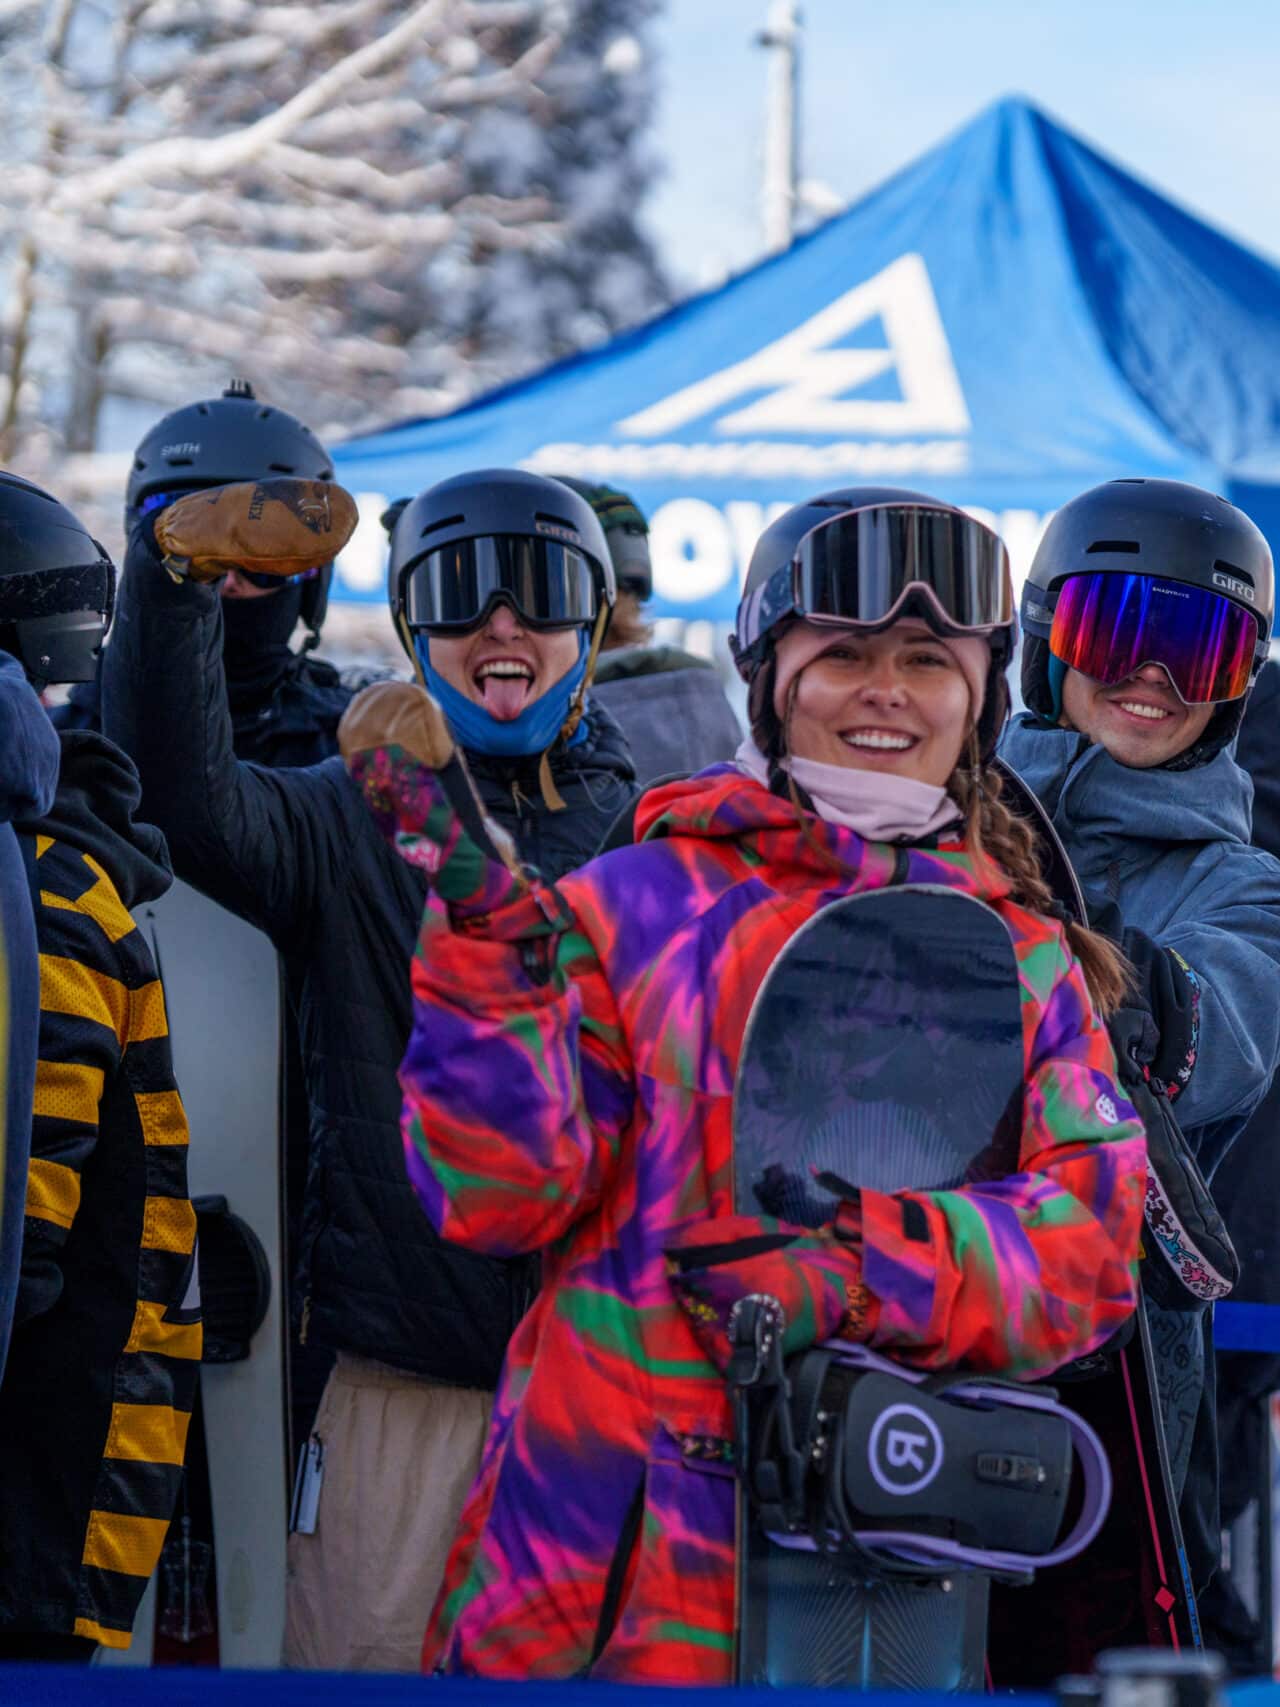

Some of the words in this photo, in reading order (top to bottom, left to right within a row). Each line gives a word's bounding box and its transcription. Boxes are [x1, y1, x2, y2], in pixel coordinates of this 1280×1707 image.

[160, 443, 201, 456] SMITH
[536, 521, 581, 543] GIRO
[1212, 572, 1254, 601] GIRO
